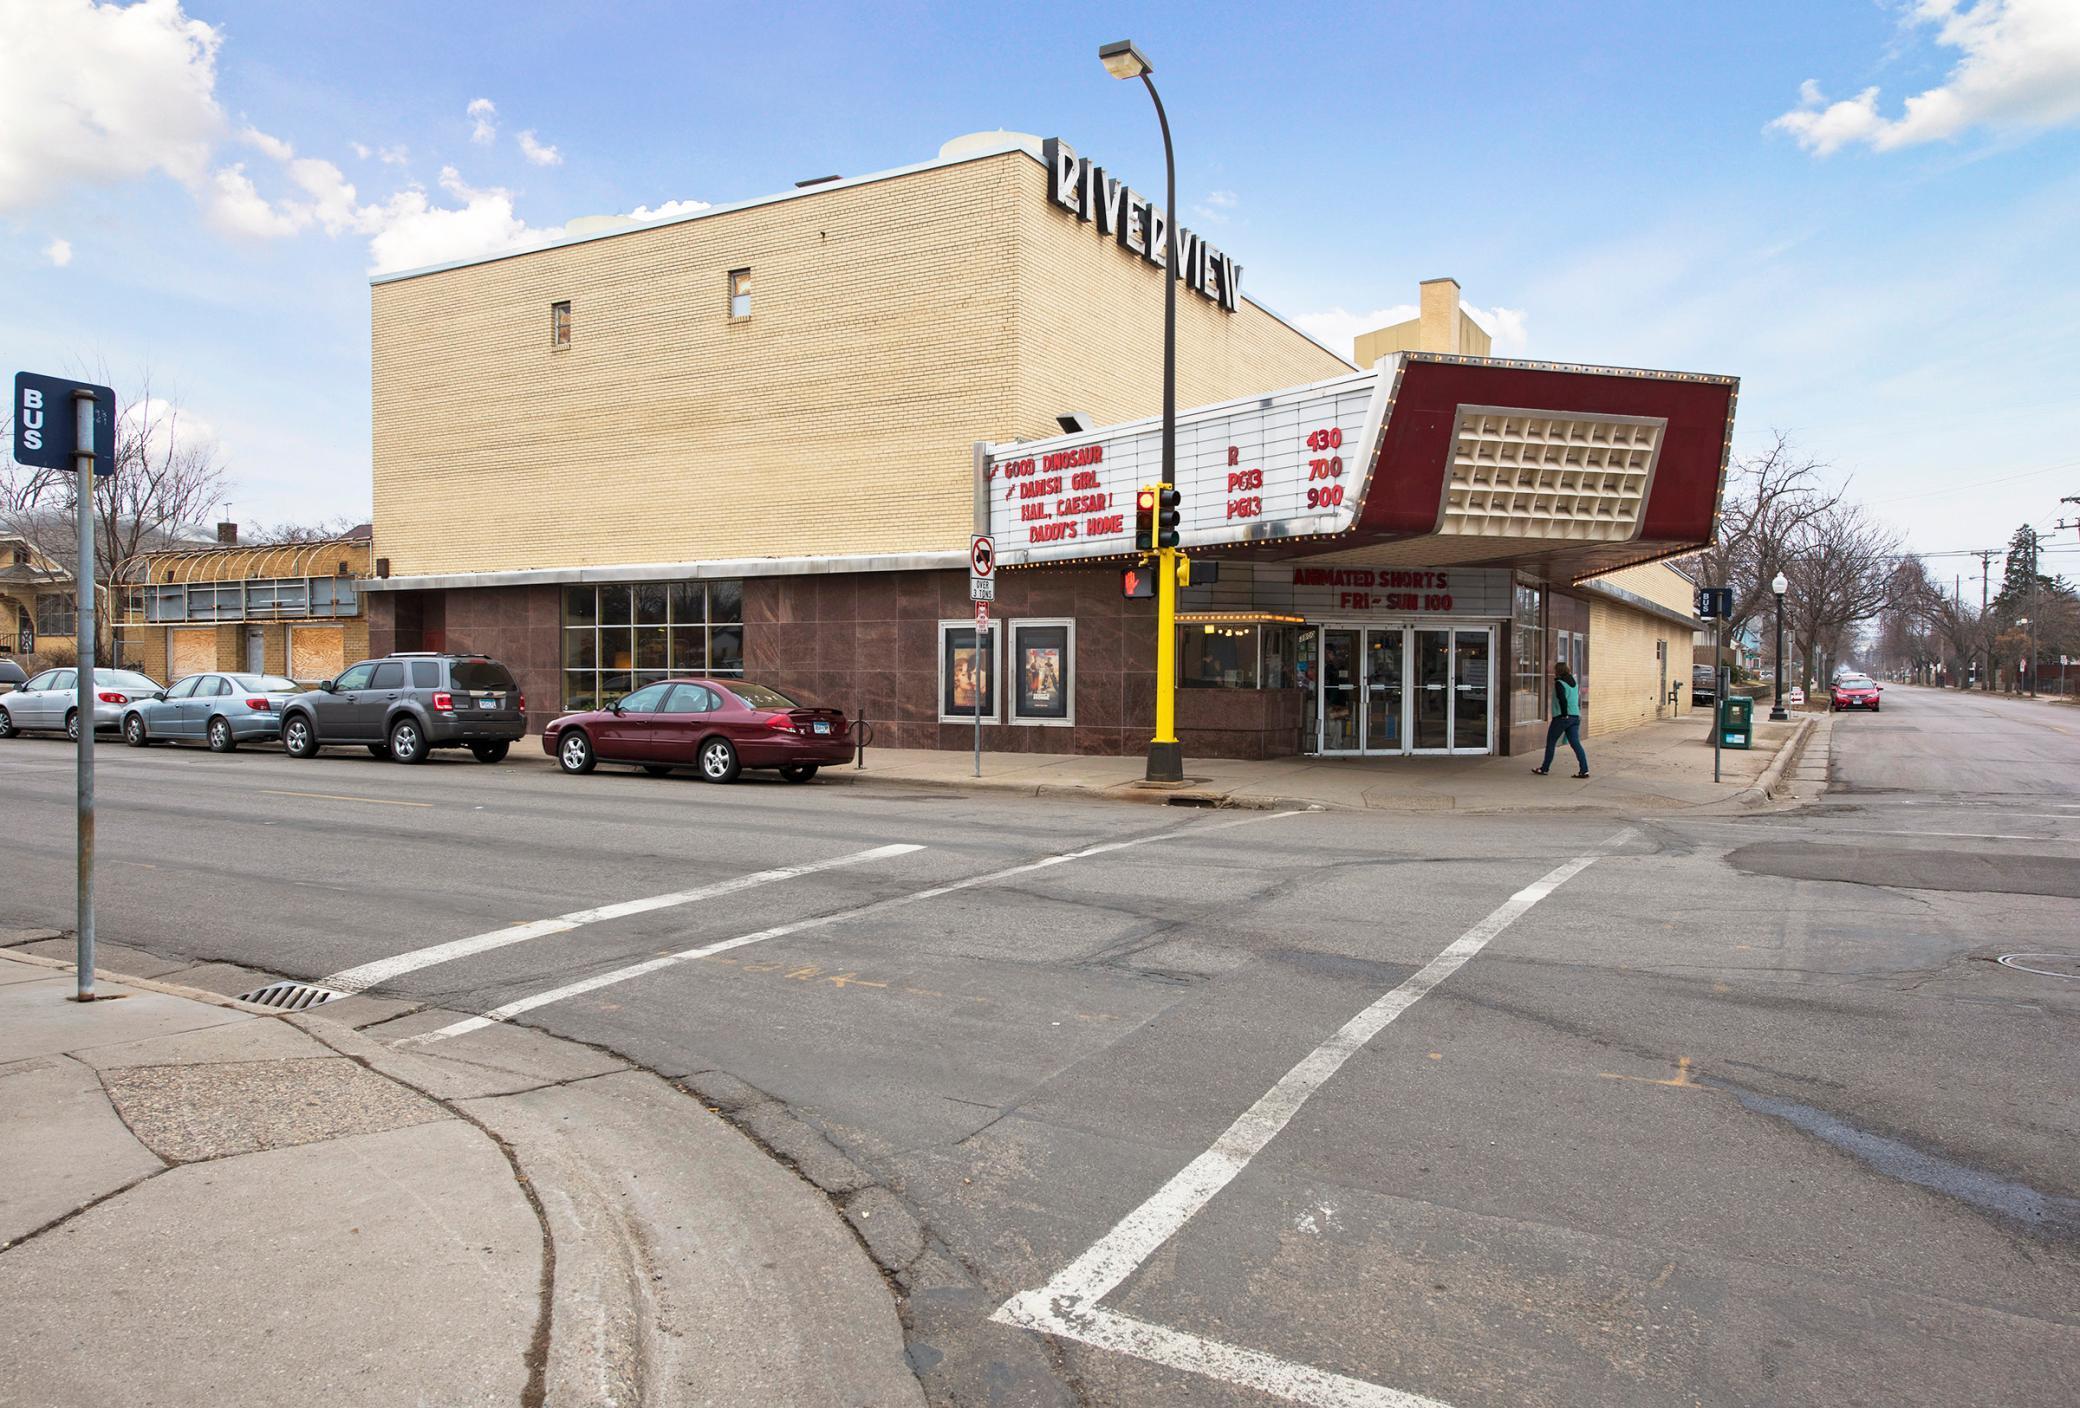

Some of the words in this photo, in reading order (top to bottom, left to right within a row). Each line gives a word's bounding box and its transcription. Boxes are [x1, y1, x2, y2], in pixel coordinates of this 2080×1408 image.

[1043, 137, 1243, 313] RIVERVIEW
[23, 388, 43, 450] BUS
[1307, 427, 1342, 452] 430
[1005, 458, 1035, 479] GOOD
[1043, 445, 1103, 473] DINOSAUR
[1227, 446, 1239, 466] R
[1309, 456, 1343, 481] 700
[1020, 476, 1062, 499] DANISH
[1072, 470, 1101, 491] GIRL
[1228, 469, 1263, 493] PG13
[1227, 496, 1262, 519] PG13
[1307, 484, 1343, 509] 900
[1021, 502, 1052, 521] HAIL,
[1029, 520, 1078, 544] DADDY'S
[1087, 514, 1124, 537] HOME
[976, 580, 990, 589] OVER
[1294, 568, 1375, 588] ANIMATED
[1379, 570, 1447, 589] SHORTS
[979, 589, 992, 599] TONS
[1340, 591, 1369, 609] FRI
[1385, 593, 1418, 610] SUN
[1424, 594, 1453, 611] 100
